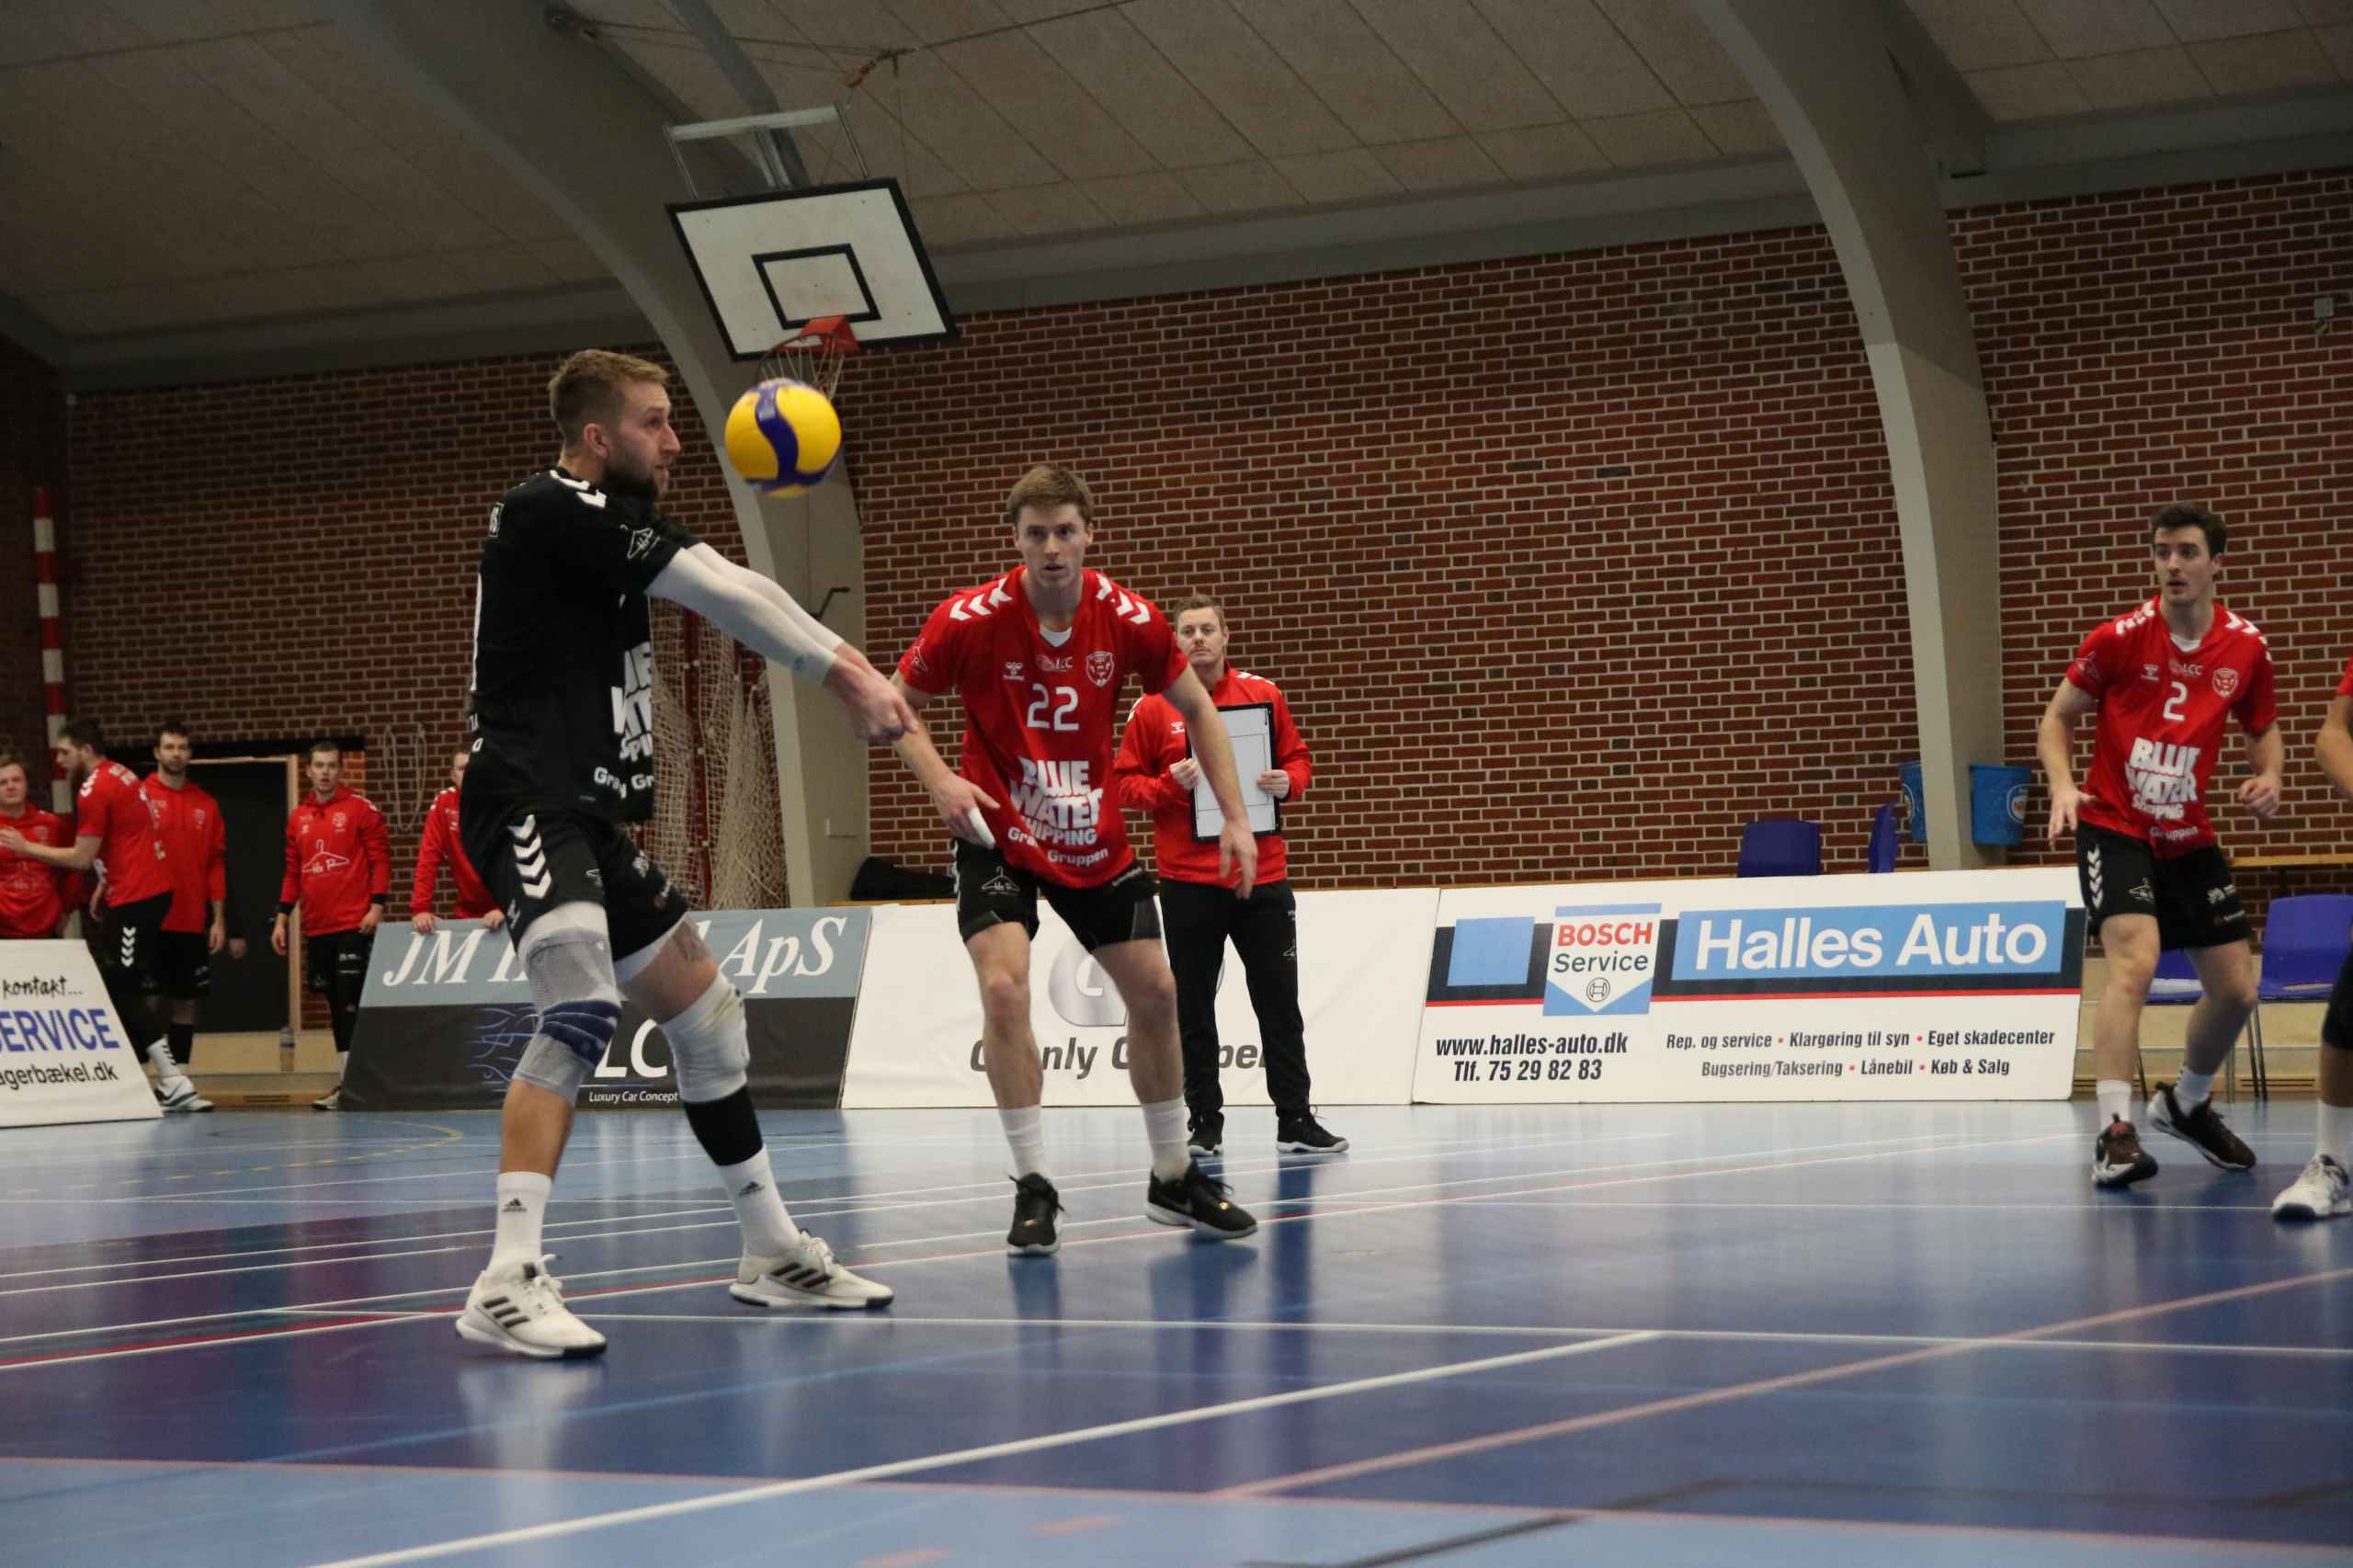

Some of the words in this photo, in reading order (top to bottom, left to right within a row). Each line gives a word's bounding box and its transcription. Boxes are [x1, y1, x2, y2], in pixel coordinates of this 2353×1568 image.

[1027, 683, 1079, 731] 22
[2163, 681, 2188, 722] 2
[1018, 756, 1091, 797] BLUE
[1020, 815, 1097, 846] HIPPING
[1557, 922, 1653, 948] BOSCH
[1695, 916, 1882, 971] Halles
[1896, 913, 2047, 967] Auto
[382, 928, 488, 986] JM
[720, 916, 847, 994] ApS
[1553, 951, 1648, 973] Service
[0, 1007, 119, 1052] ERVICE
[1436, 1033, 1628, 1056] www.halles-auto.dk
[1666, 1034, 1696, 1049] Rep.
[1700, 1036, 1717, 1049] og
[1722, 1034, 1772, 1048] service
[1790, 1030, 1862, 1049] Klargøring
[1867, 1028, 1881, 1047] til
[1886, 1033, 1910, 1049] syn
[1928, 1029, 1960, 1046] Eget
[1964, 1028, 2055, 1045] skadecenter
[1453, 1061, 1480, 1082] Tlf.
[1488, 1060, 1511, 1082] 75
[1517, 1060, 1541, 1082] 29
[1547, 1059, 1571, 1081] 82
[1577, 1059, 1602, 1081] 83
[1701, 1060, 1843, 1077] Bugsering/Taksering
[1861, 1058, 1913, 1074] Lånebil
[1931, 1059, 1958, 1074] Køb
[1962, 1060, 1972, 1074] &
[1978, 1058, 2009, 1075] Salg
[588, 1091, 620, 1105] Luxury
[621, 1091, 638, 1102] Car
[639, 1091, 678, 1103] Concept
